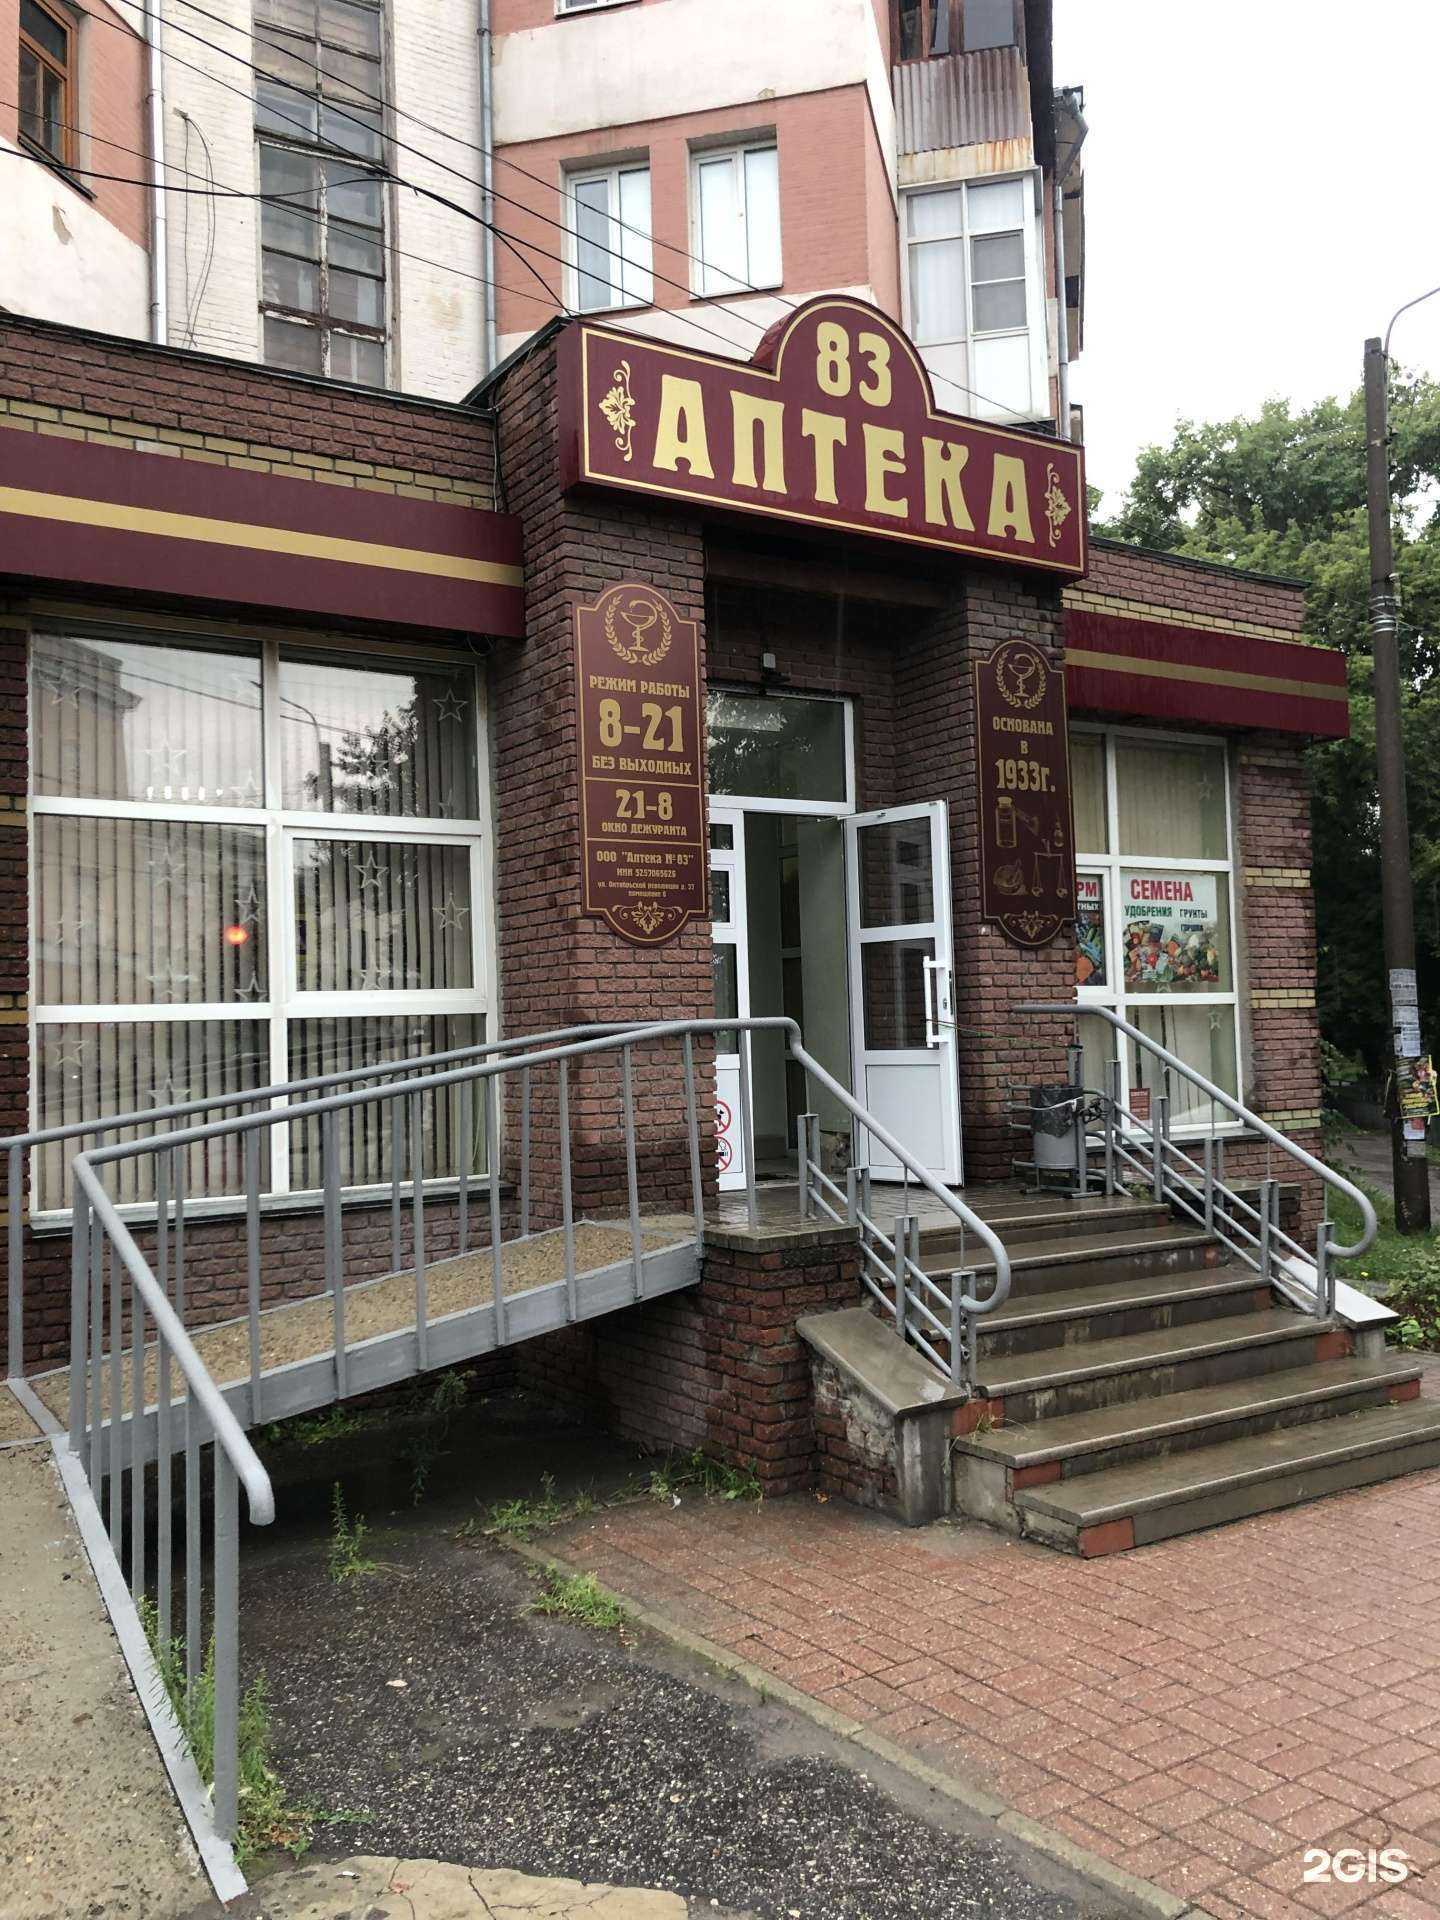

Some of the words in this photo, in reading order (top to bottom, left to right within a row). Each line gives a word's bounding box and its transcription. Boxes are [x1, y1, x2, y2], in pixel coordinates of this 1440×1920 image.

[816, 321, 892, 407] 83
[652, 374, 1036, 543] АПТЕКА
[589, 675, 637, 693] РЕЖИМ
[641, 680, 690, 699] РАБОТЫ
[599, 698, 684, 753] 8-21
[992, 716, 1054, 735] ОСНОВАНА
[1020, 740, 1029, 754] В
[592, 755, 616, 769] БЕЗ
[619, 757, 692, 776] ВЫХОДНЫХ
[995, 758, 1056, 793] 1933г.
[615, 788, 673, 820] 21-8
[601, 822, 628, 833] ОКНО
[631, 824, 688, 836] ДЕЖУРАНТА
[596, 850, 617, 862] ООО
[1076, 881, 1097, 897] РМ
[1130, 878, 1194, 902] СЕМЕНА
[1077, 902, 1099, 911] ТНЫХ
[1124, 905, 1172, 918] УДОБРЕНИЯ
